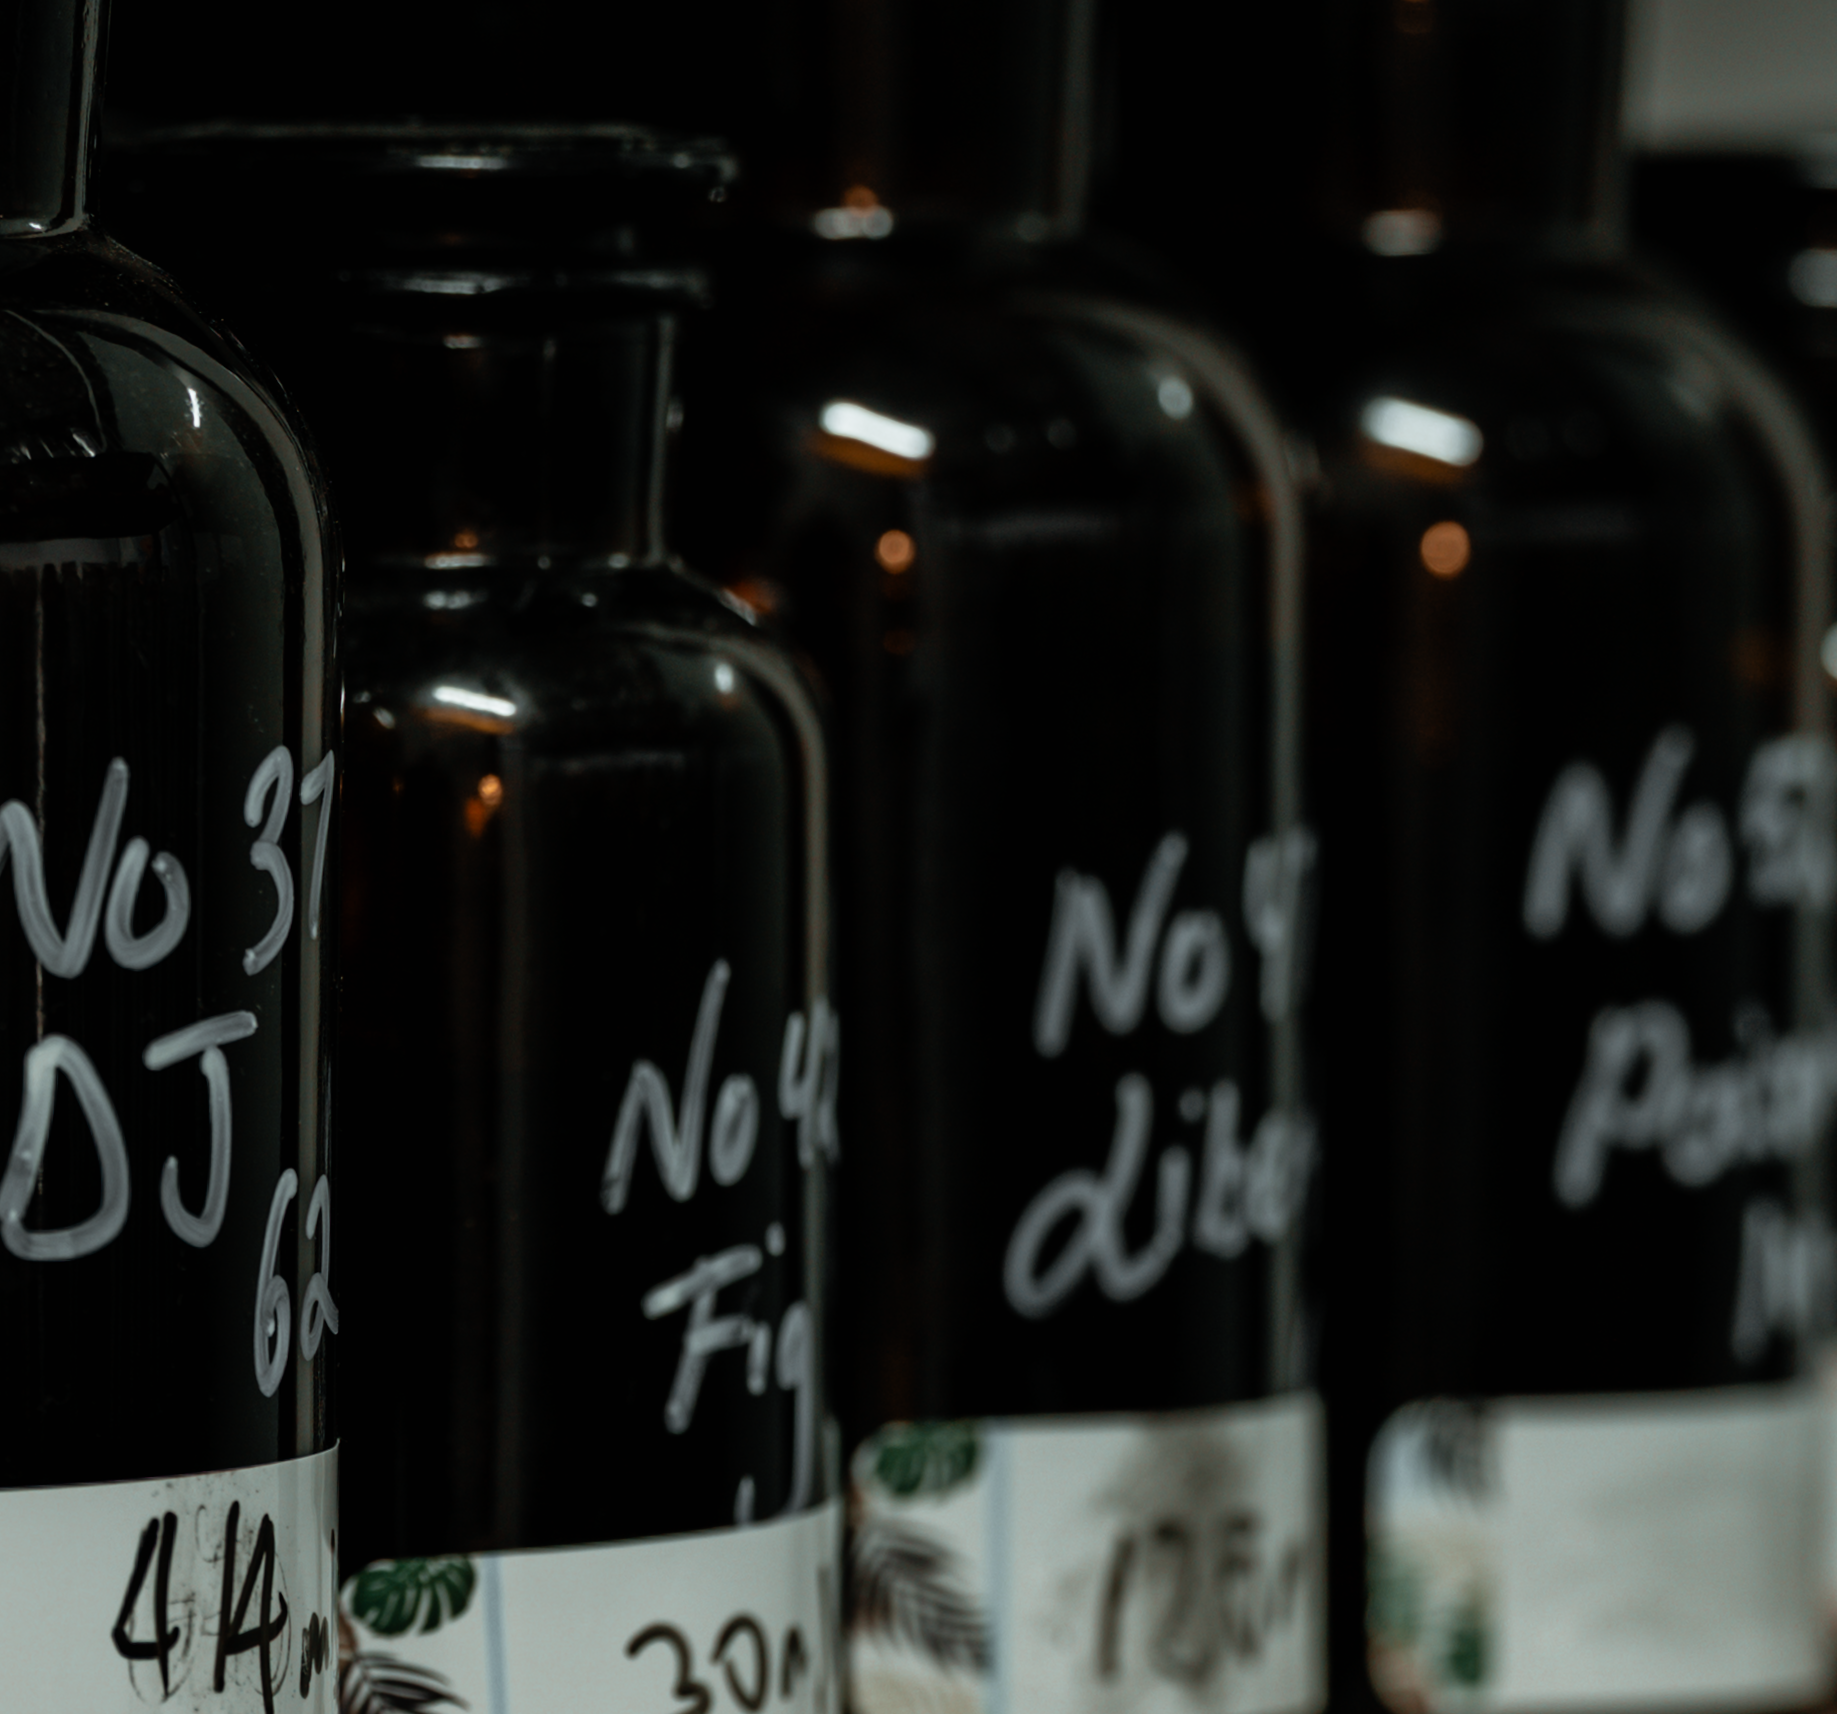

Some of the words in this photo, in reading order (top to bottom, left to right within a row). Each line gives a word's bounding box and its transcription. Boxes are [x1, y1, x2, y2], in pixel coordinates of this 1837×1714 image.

[243, 744, 335, 976] 37
[1031, 827, 1231, 1061] No
[597, 957, 761, 1215] No
